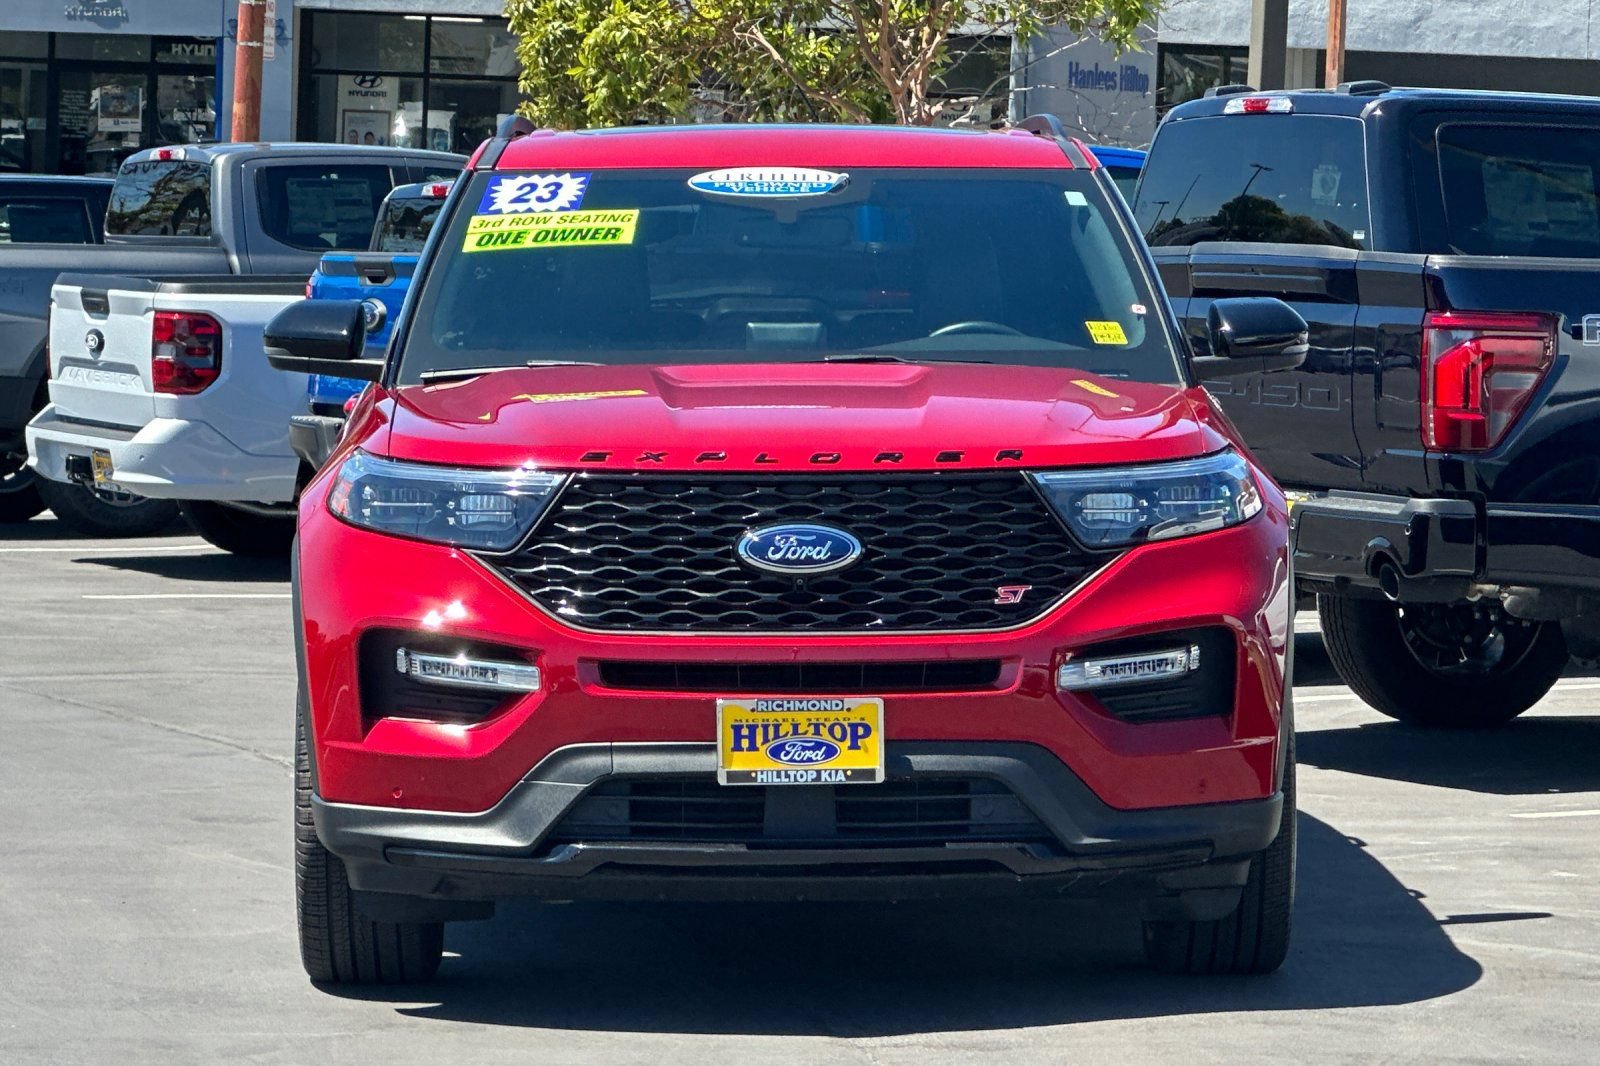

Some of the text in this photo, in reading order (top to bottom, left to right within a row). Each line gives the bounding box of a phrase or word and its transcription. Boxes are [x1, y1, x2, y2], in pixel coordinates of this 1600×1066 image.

[1068, 61, 1149, 98] Hanlees Hilltop
[348, 90, 387, 98] HYUNDAI
[511, 181, 563, 205] 23
[473, 212, 634, 230] 3rd ROW SEATING
[475, 226, 622, 248] ONE OWNER
[579, 448, 1024, 465] EXPLORER
[766, 534, 832, 562] Ford
[993, 585, 1032, 604] ST
[757, 700, 844, 712] RICHMOND
[730, 722, 872, 752] HILLTOP
[780, 741, 826, 761] Ford
[757, 770, 846, 783] HILLTOP KIA
